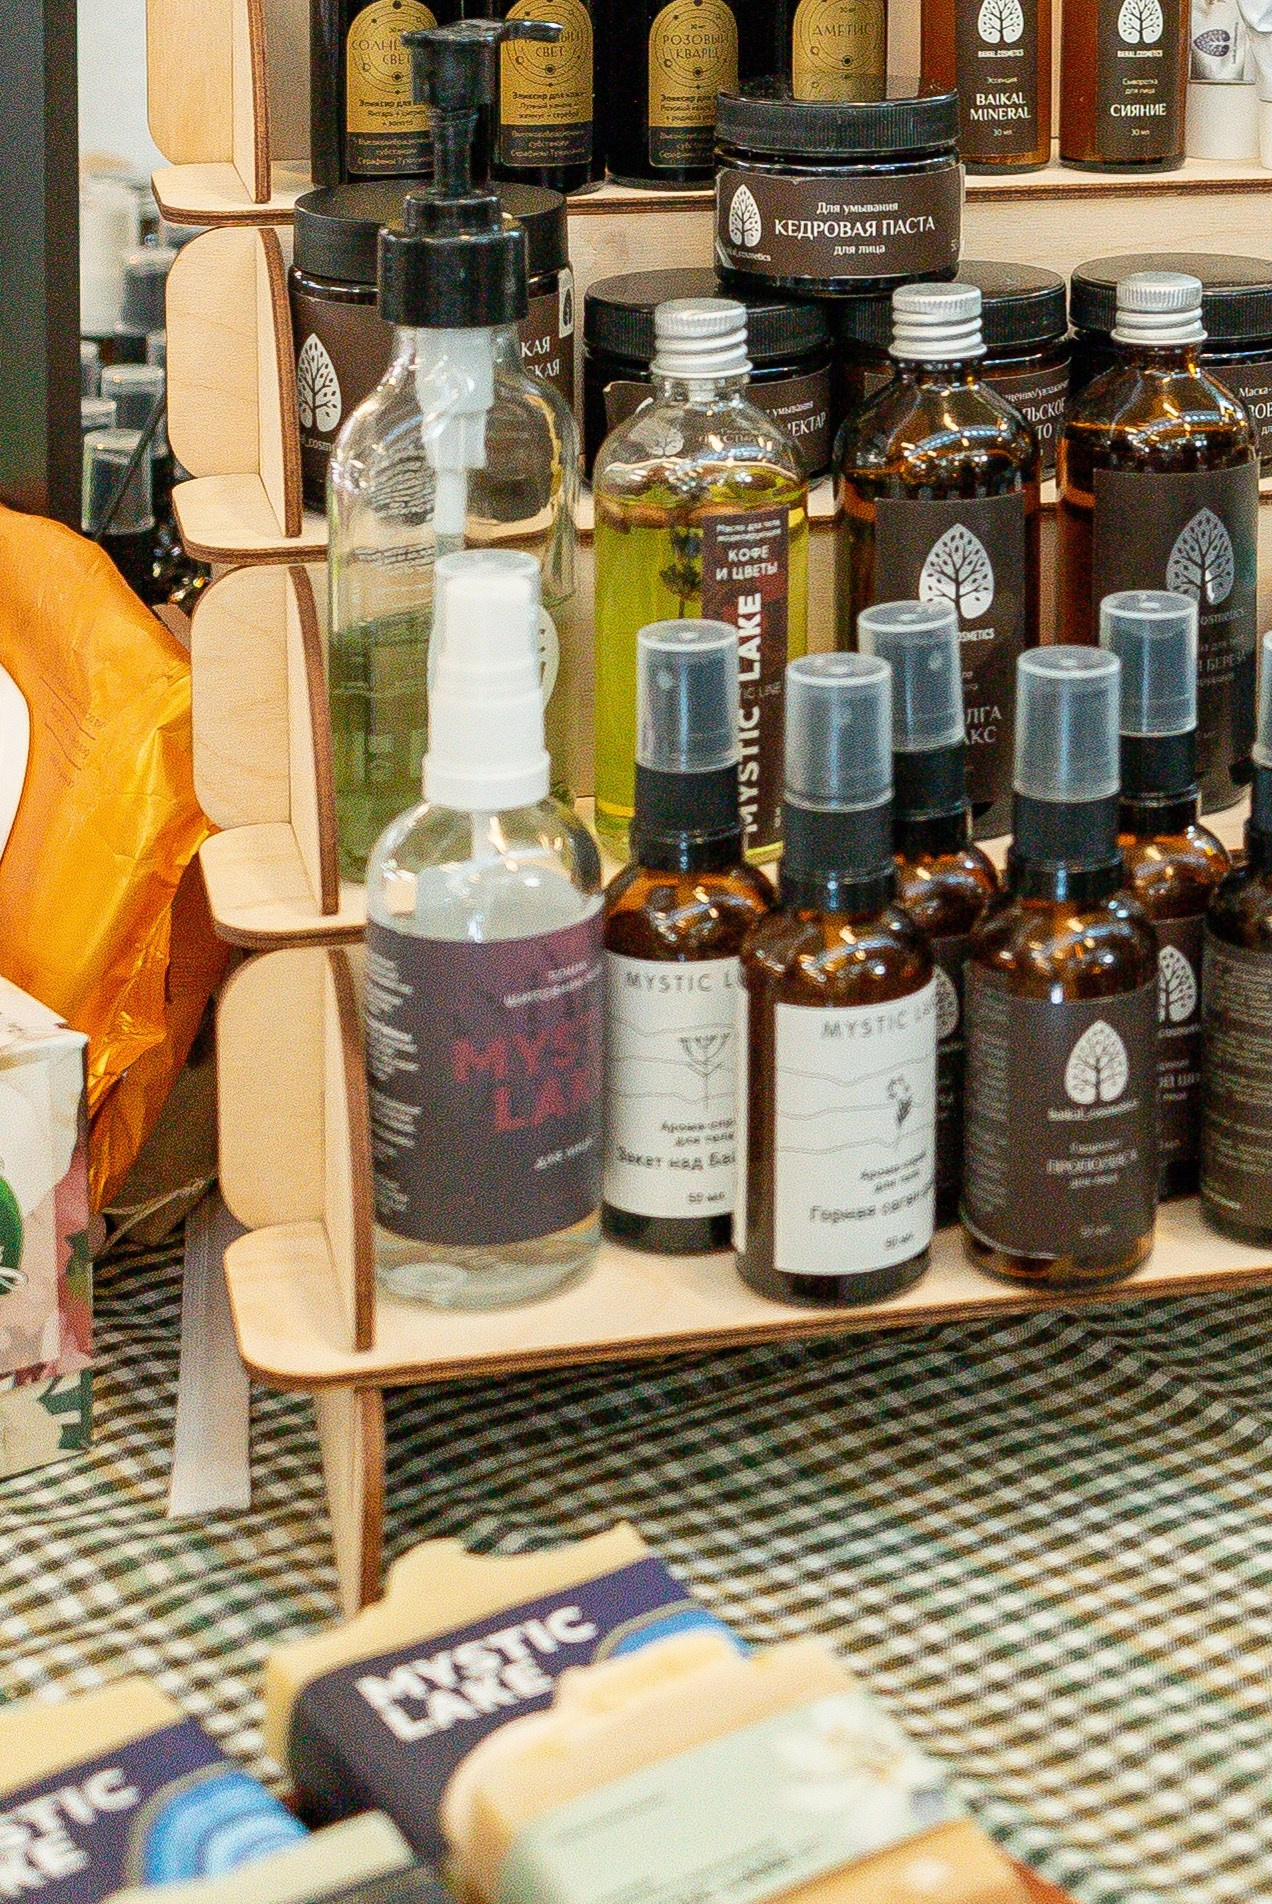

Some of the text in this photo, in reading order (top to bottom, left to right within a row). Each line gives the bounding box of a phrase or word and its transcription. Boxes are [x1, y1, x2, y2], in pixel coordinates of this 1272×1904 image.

[811, 23, 872, 38] АМЕТИС
[976, 92, 1027, 106] BAIKAL
[969, 105, 1031, 121] MINERAL
[1110, 102, 1167, 117] СИЯНИЕ
[816, 200, 899, 215] Для умывания
[774, 215, 936, 240] КЕДРОВАЯ ПАСТА
[833, 243, 886, 256] для лица
[787, 411, 826, 437] ЕКТАР
[728, 545, 770, 562] КОФЕ
[716, 562, 777, 580] И ЦВЕТЫ
[737, 592, 762, 833] MYSTIC LAKE
[626, 971, 712, 994] MYSTIC
[819, 1008, 908, 1042] MYSTIC
[355, 1605, 599, 1714] MYSTIC
[380, 1667, 556, 1743] LAKE
[0, 1768, 141, 1851] STIC
